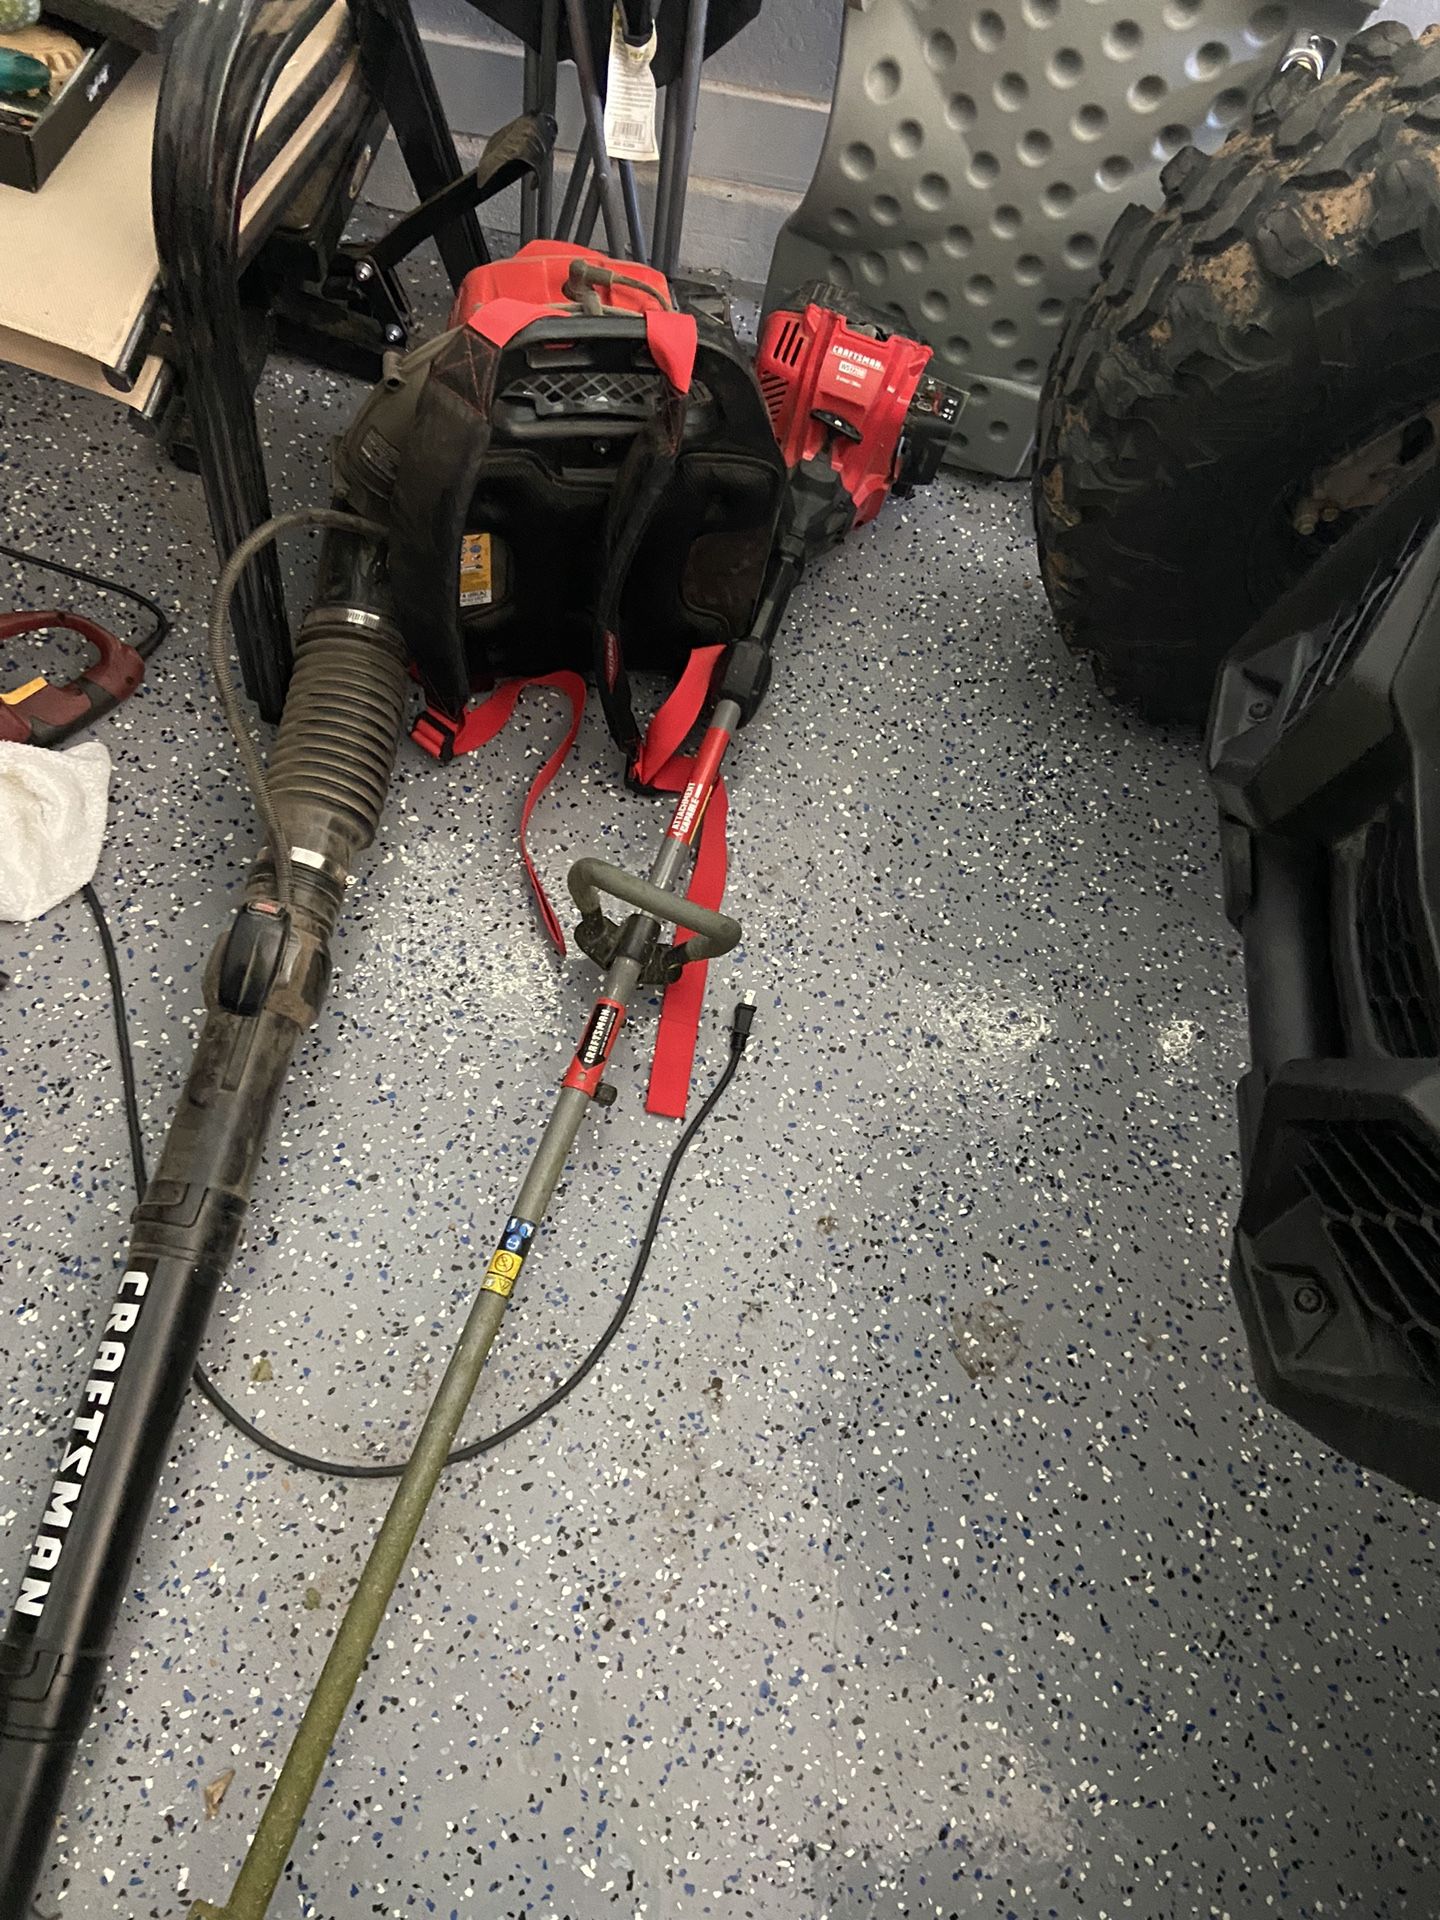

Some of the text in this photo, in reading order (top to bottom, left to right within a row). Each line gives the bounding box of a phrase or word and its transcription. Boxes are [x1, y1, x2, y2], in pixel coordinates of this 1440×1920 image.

[832, 345, 882, 369] CRAFTSMAN
[672, 782, 695, 829] ATTACHMENT
[584, 1008, 610, 1064] CRAFTSMAN
[15, 1270, 149, 1617] CRAFTSMAN
